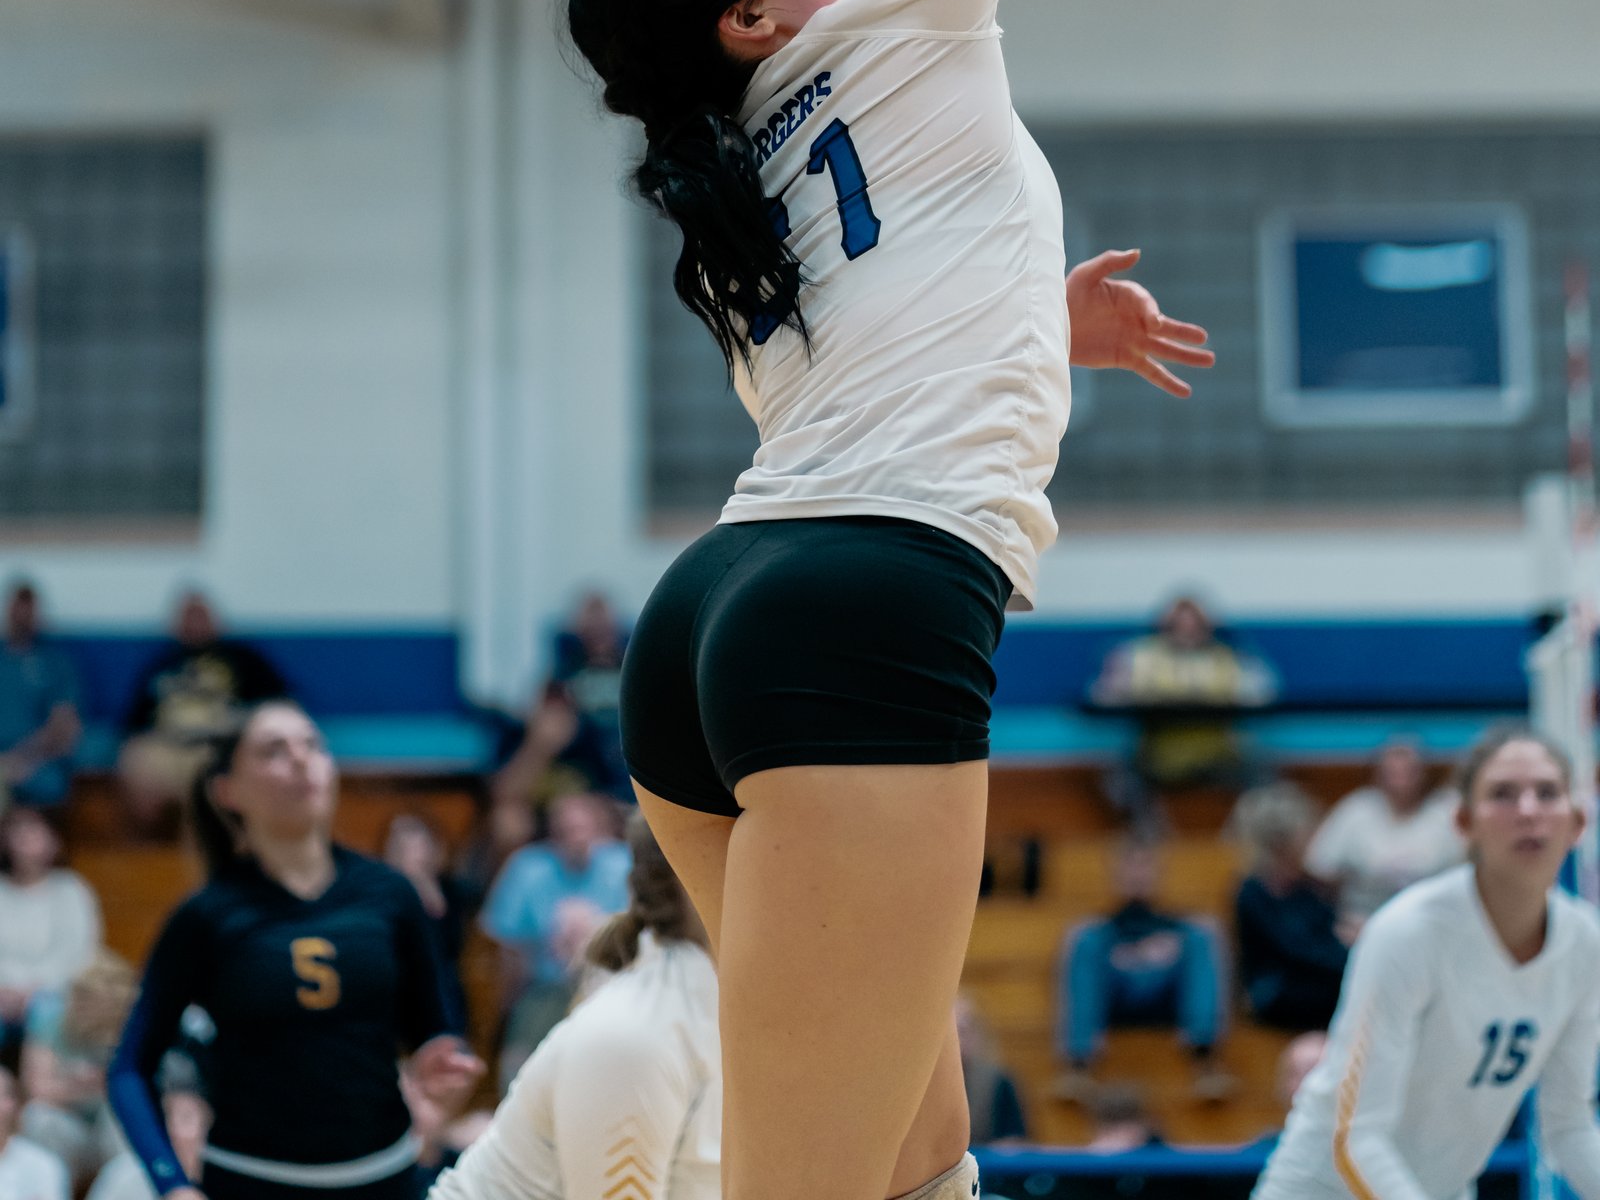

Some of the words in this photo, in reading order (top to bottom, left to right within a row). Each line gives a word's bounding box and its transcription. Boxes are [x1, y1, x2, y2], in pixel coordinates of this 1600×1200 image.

[752, 71, 832, 169] RGERS
[290, 936, 341, 1011] 5
[1468, 1019, 1538, 1088] 15
